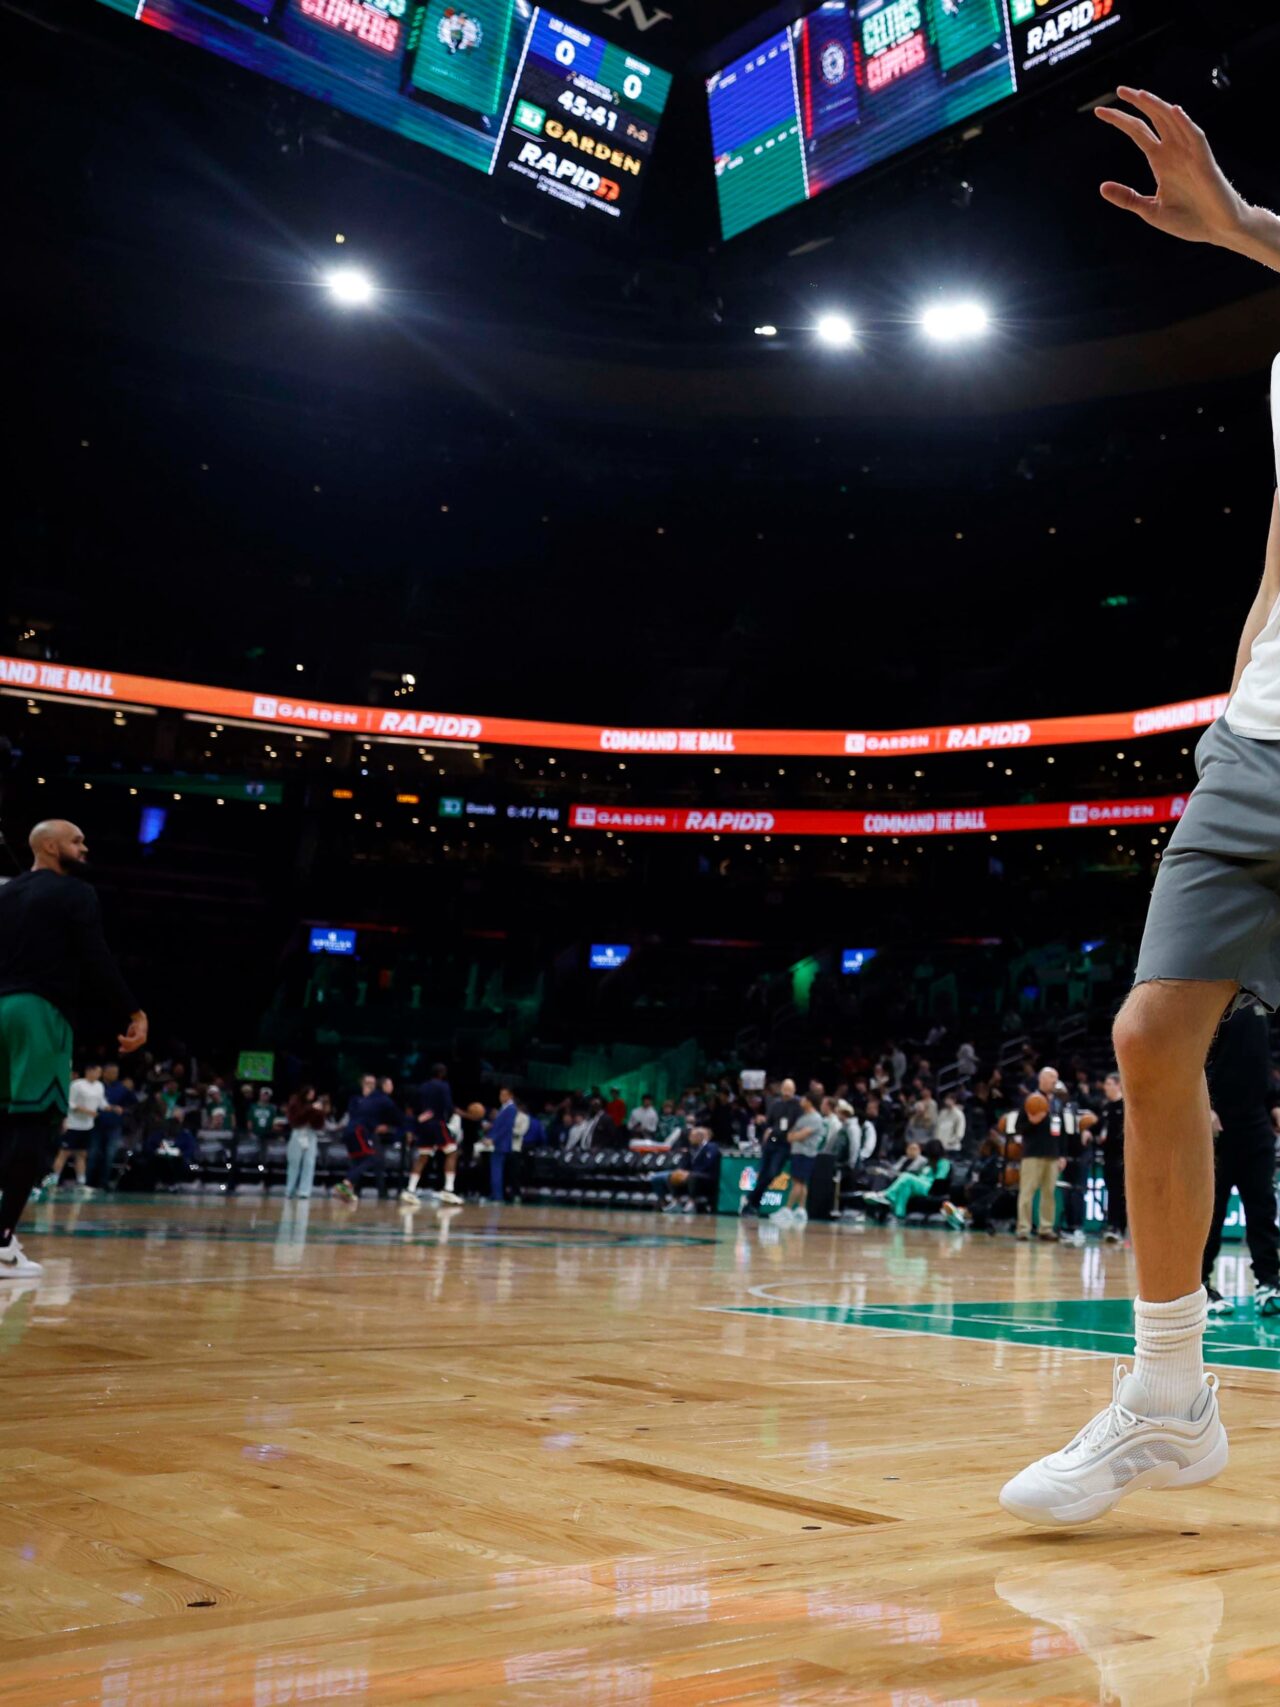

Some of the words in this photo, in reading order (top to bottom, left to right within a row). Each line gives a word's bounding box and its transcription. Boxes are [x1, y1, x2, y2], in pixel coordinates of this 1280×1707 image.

[555, 40, 575, 65] 0
[623, 74, 642, 99] 0
[545, 119, 641, 176] GARDEN
[67, 670, 115, 695] BALL
[278, 703, 358, 725] GARDEN
[601, 730, 677, 750] COMMAND
[700, 731, 735, 751] BALL
[866, 735, 930, 750] GARDEN
[507, 805, 535, 819] 6:47
[538, 807, 559, 820] PM
[597, 812, 666, 826] GARDEN
[864, 812, 935, 832] COMMAND
[954, 811, 986, 829] BALL
[1089, 805, 1154, 820] GARDEN
